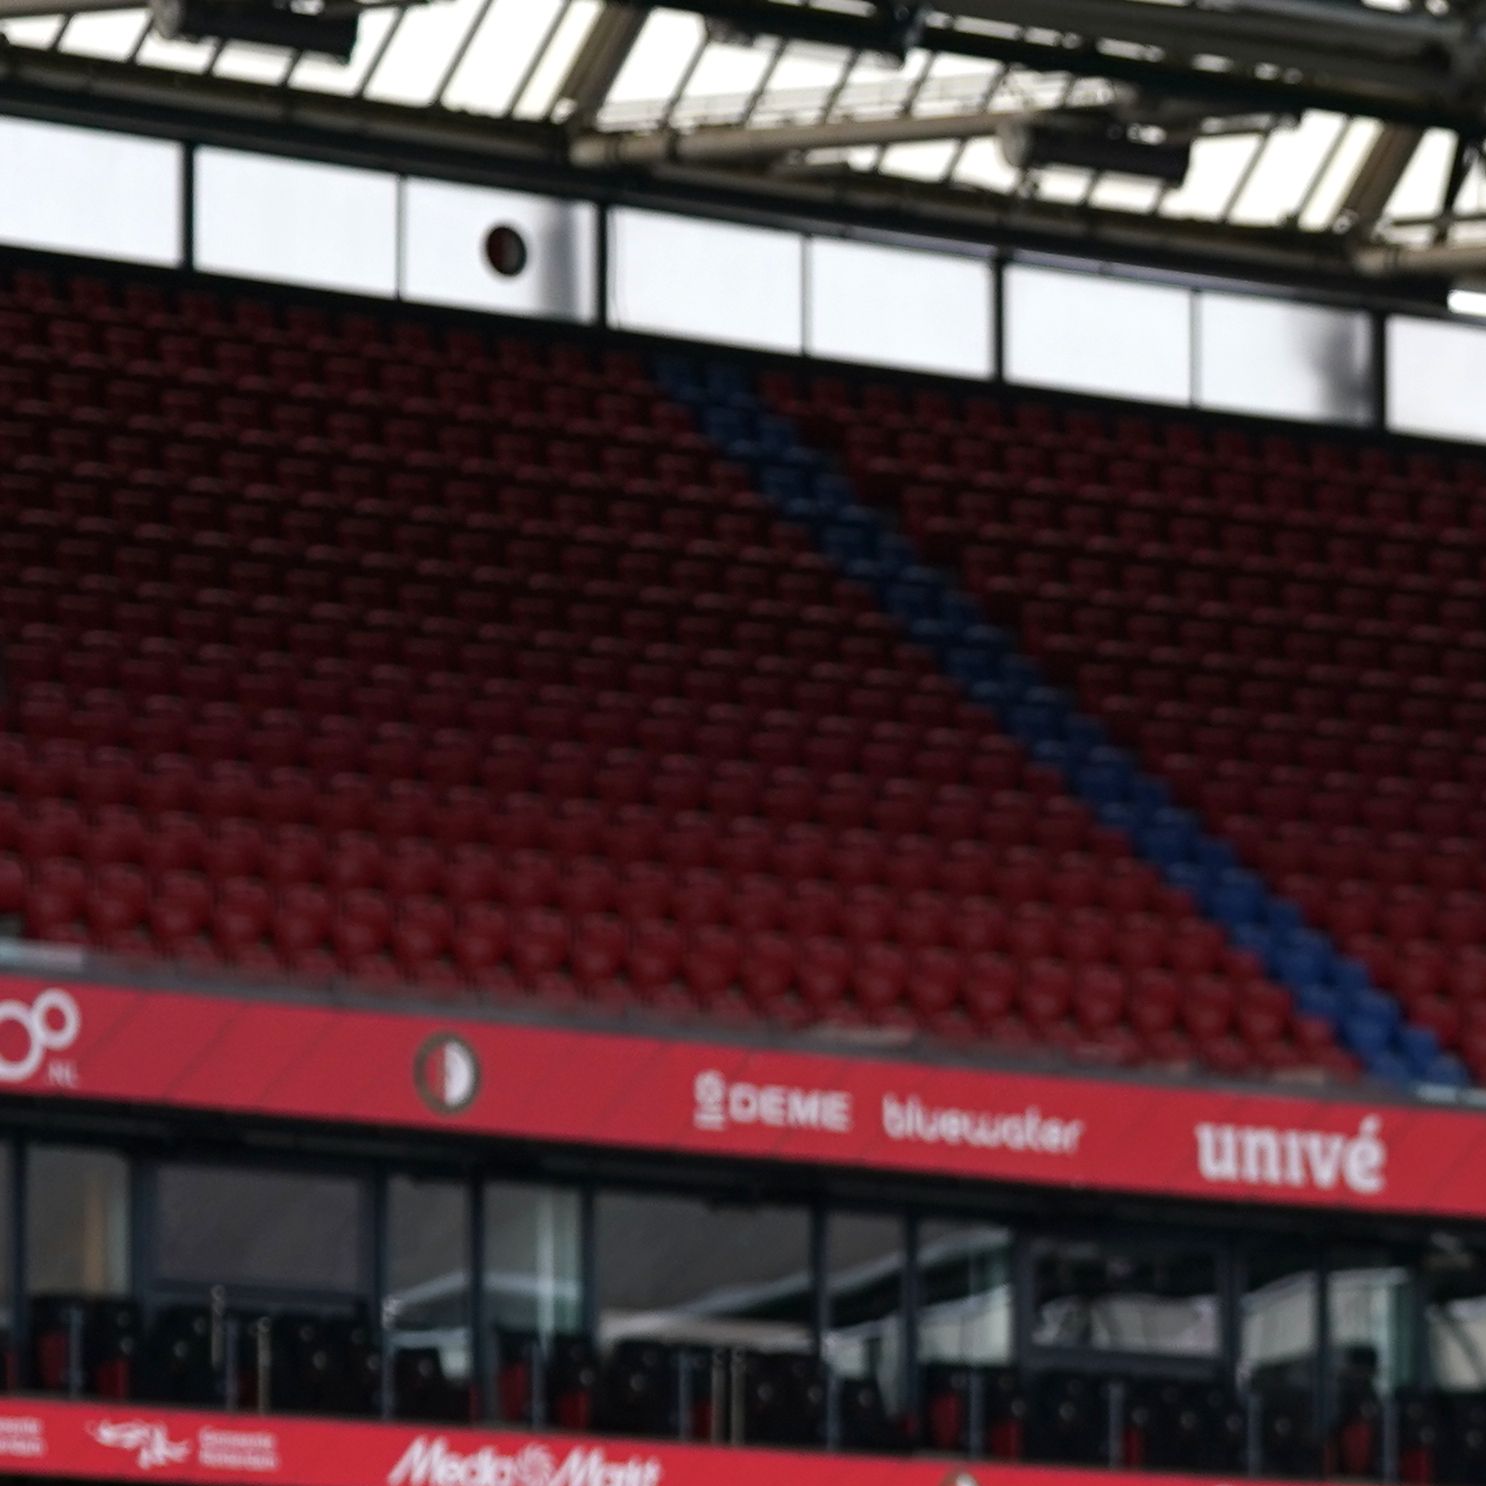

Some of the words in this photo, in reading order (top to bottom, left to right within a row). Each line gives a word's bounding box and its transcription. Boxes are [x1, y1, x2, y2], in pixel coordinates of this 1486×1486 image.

[727, 1083, 851, 1132] DEME
[882, 1093, 1084, 1154] bluewater
[1194, 1113, 1387, 1194] univé
